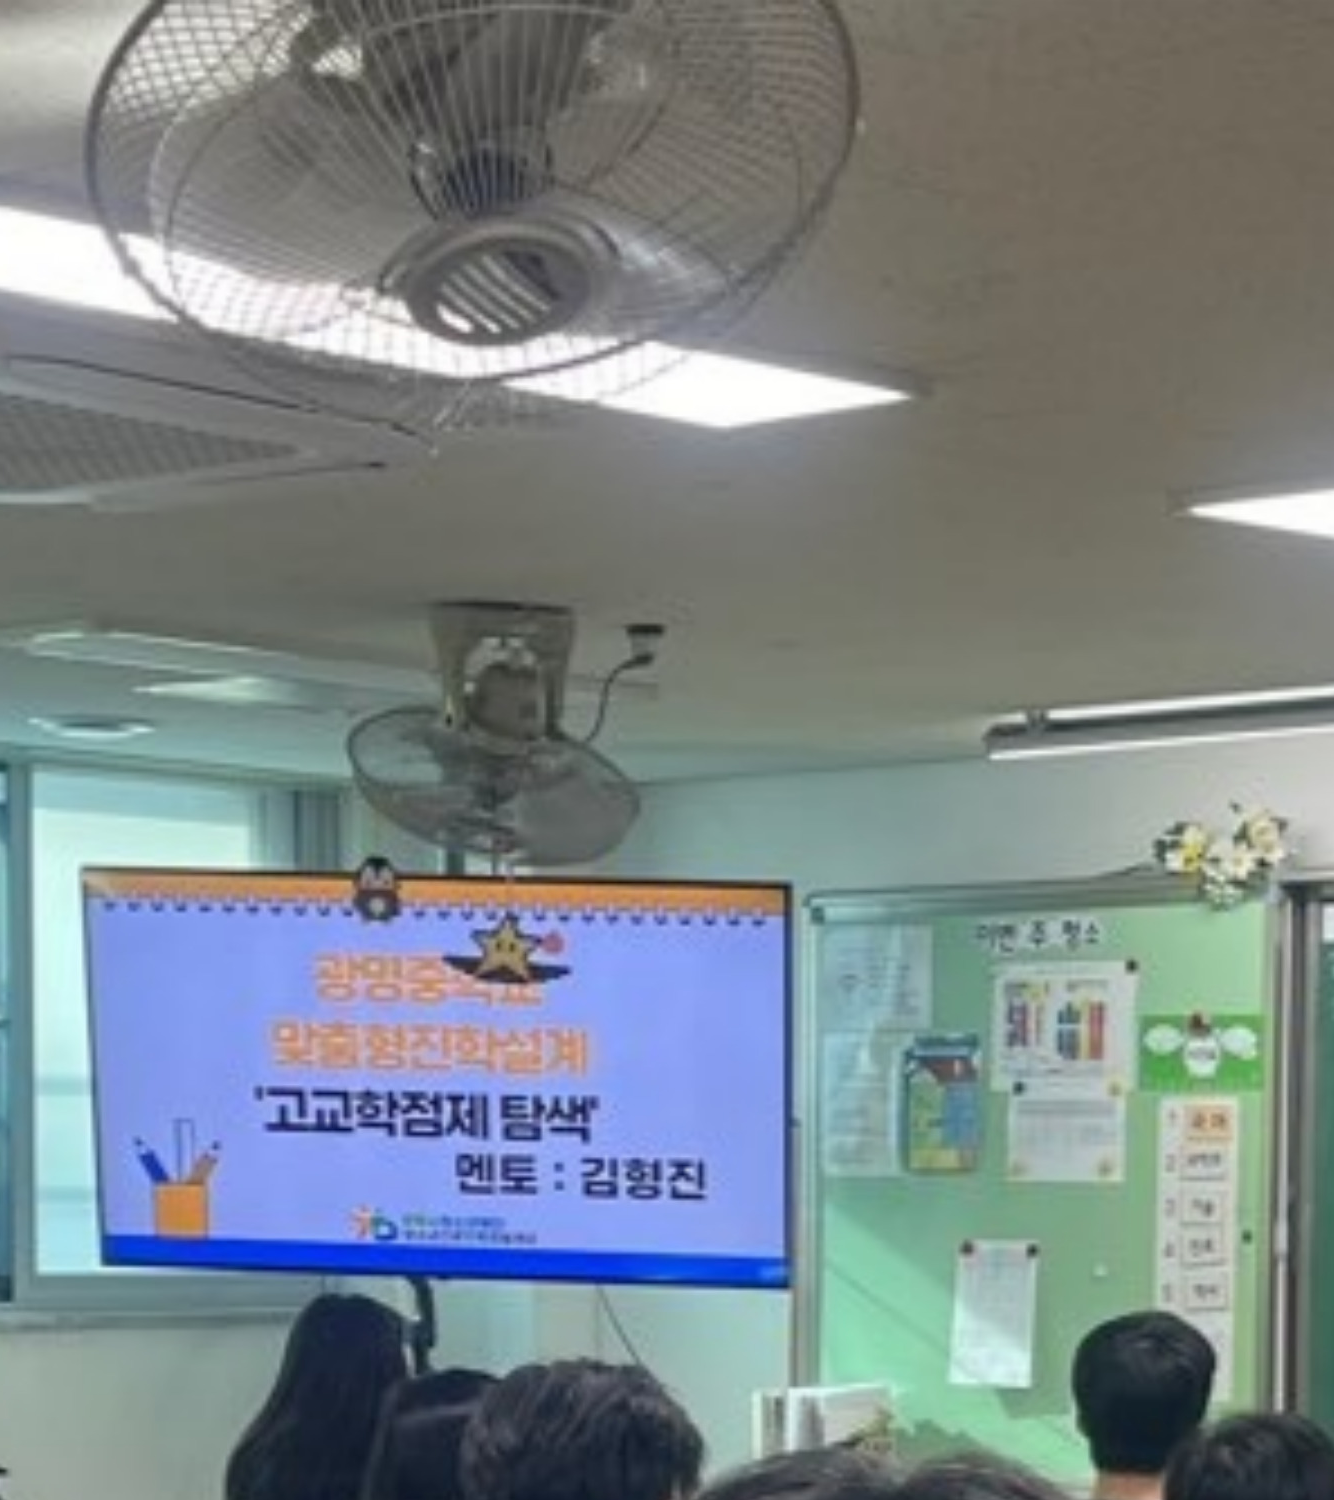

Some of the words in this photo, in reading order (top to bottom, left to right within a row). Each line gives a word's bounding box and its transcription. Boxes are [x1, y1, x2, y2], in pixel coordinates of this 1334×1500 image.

[271, 1020, 588, 1077] 맞춤형진학설계
[454, 1154, 539, 1197] 멘토
[581, 1158, 708, 1201] 김형진
